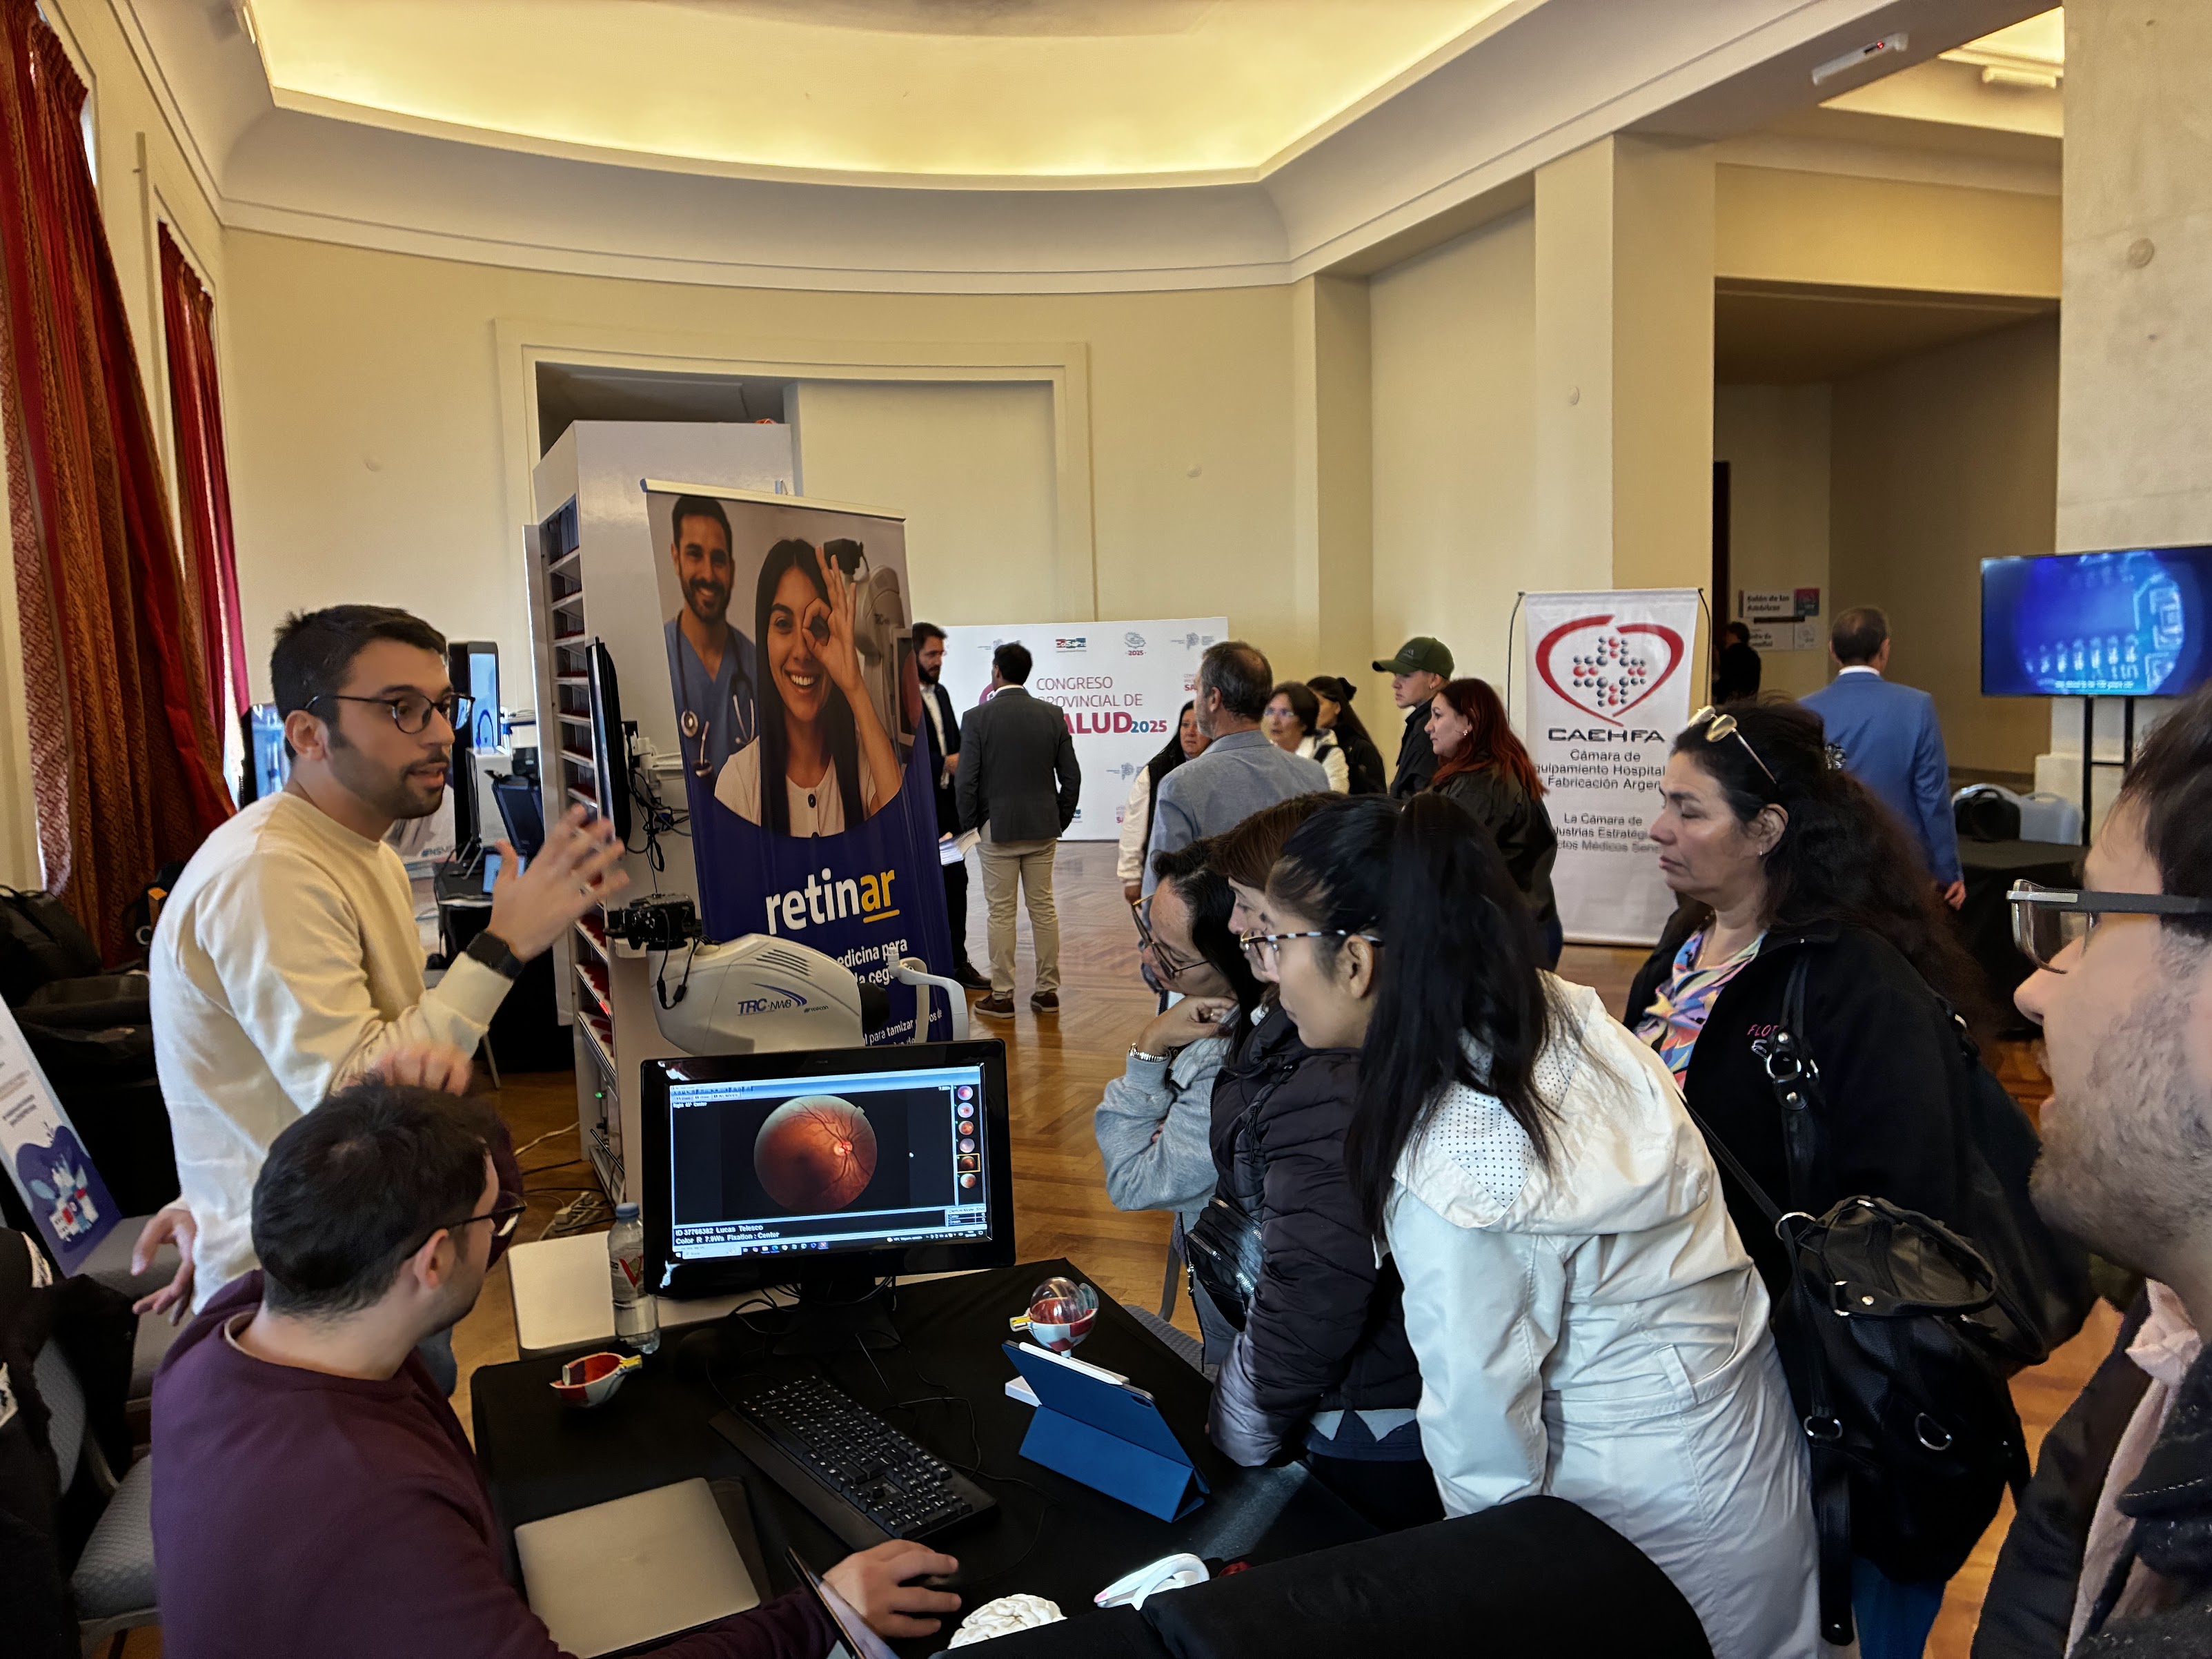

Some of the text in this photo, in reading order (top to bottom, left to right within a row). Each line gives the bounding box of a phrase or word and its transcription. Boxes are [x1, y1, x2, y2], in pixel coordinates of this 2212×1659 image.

[1036, 676, 1113, 691] CONGRESO
[1124, 694, 1143, 706] DE
[1548, 727, 1666, 743] CAEHFA
[1570, 749, 1641, 763] Cámara de
[1548, 776, 1661, 791] Fabricación Argen
[1564, 812, 1643, 826] La Cámara de
[765, 867, 896, 935] retinar
[869, 1030, 887, 1046] para
[886, 1019, 914, 1037] tamizar
[738, 1224, 764, 1233] Telesco
[727, 1233, 753, 1241] Fixation
